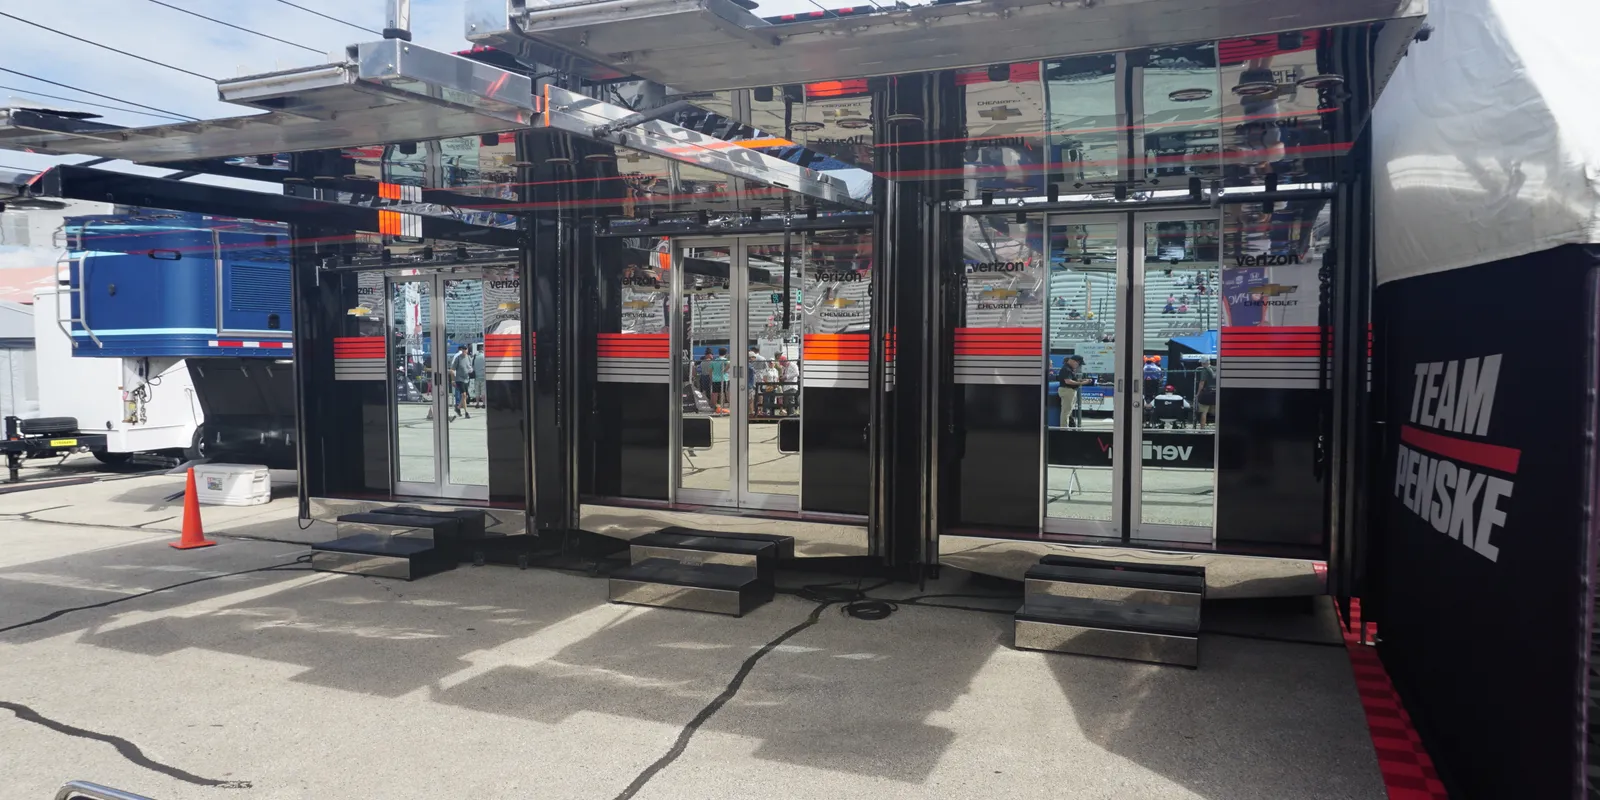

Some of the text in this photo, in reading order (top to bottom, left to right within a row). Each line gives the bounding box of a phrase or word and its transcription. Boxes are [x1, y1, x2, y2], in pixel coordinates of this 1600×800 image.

[971, 259, 1025, 273] verizon
[1236, 252, 1299, 267] verizon
[814, 270, 862, 282] verizon
[490, 278, 520, 289] verizo
[1410, 354, 1503, 437] TEAM
[1394, 444, 1514, 563] PENSKE
